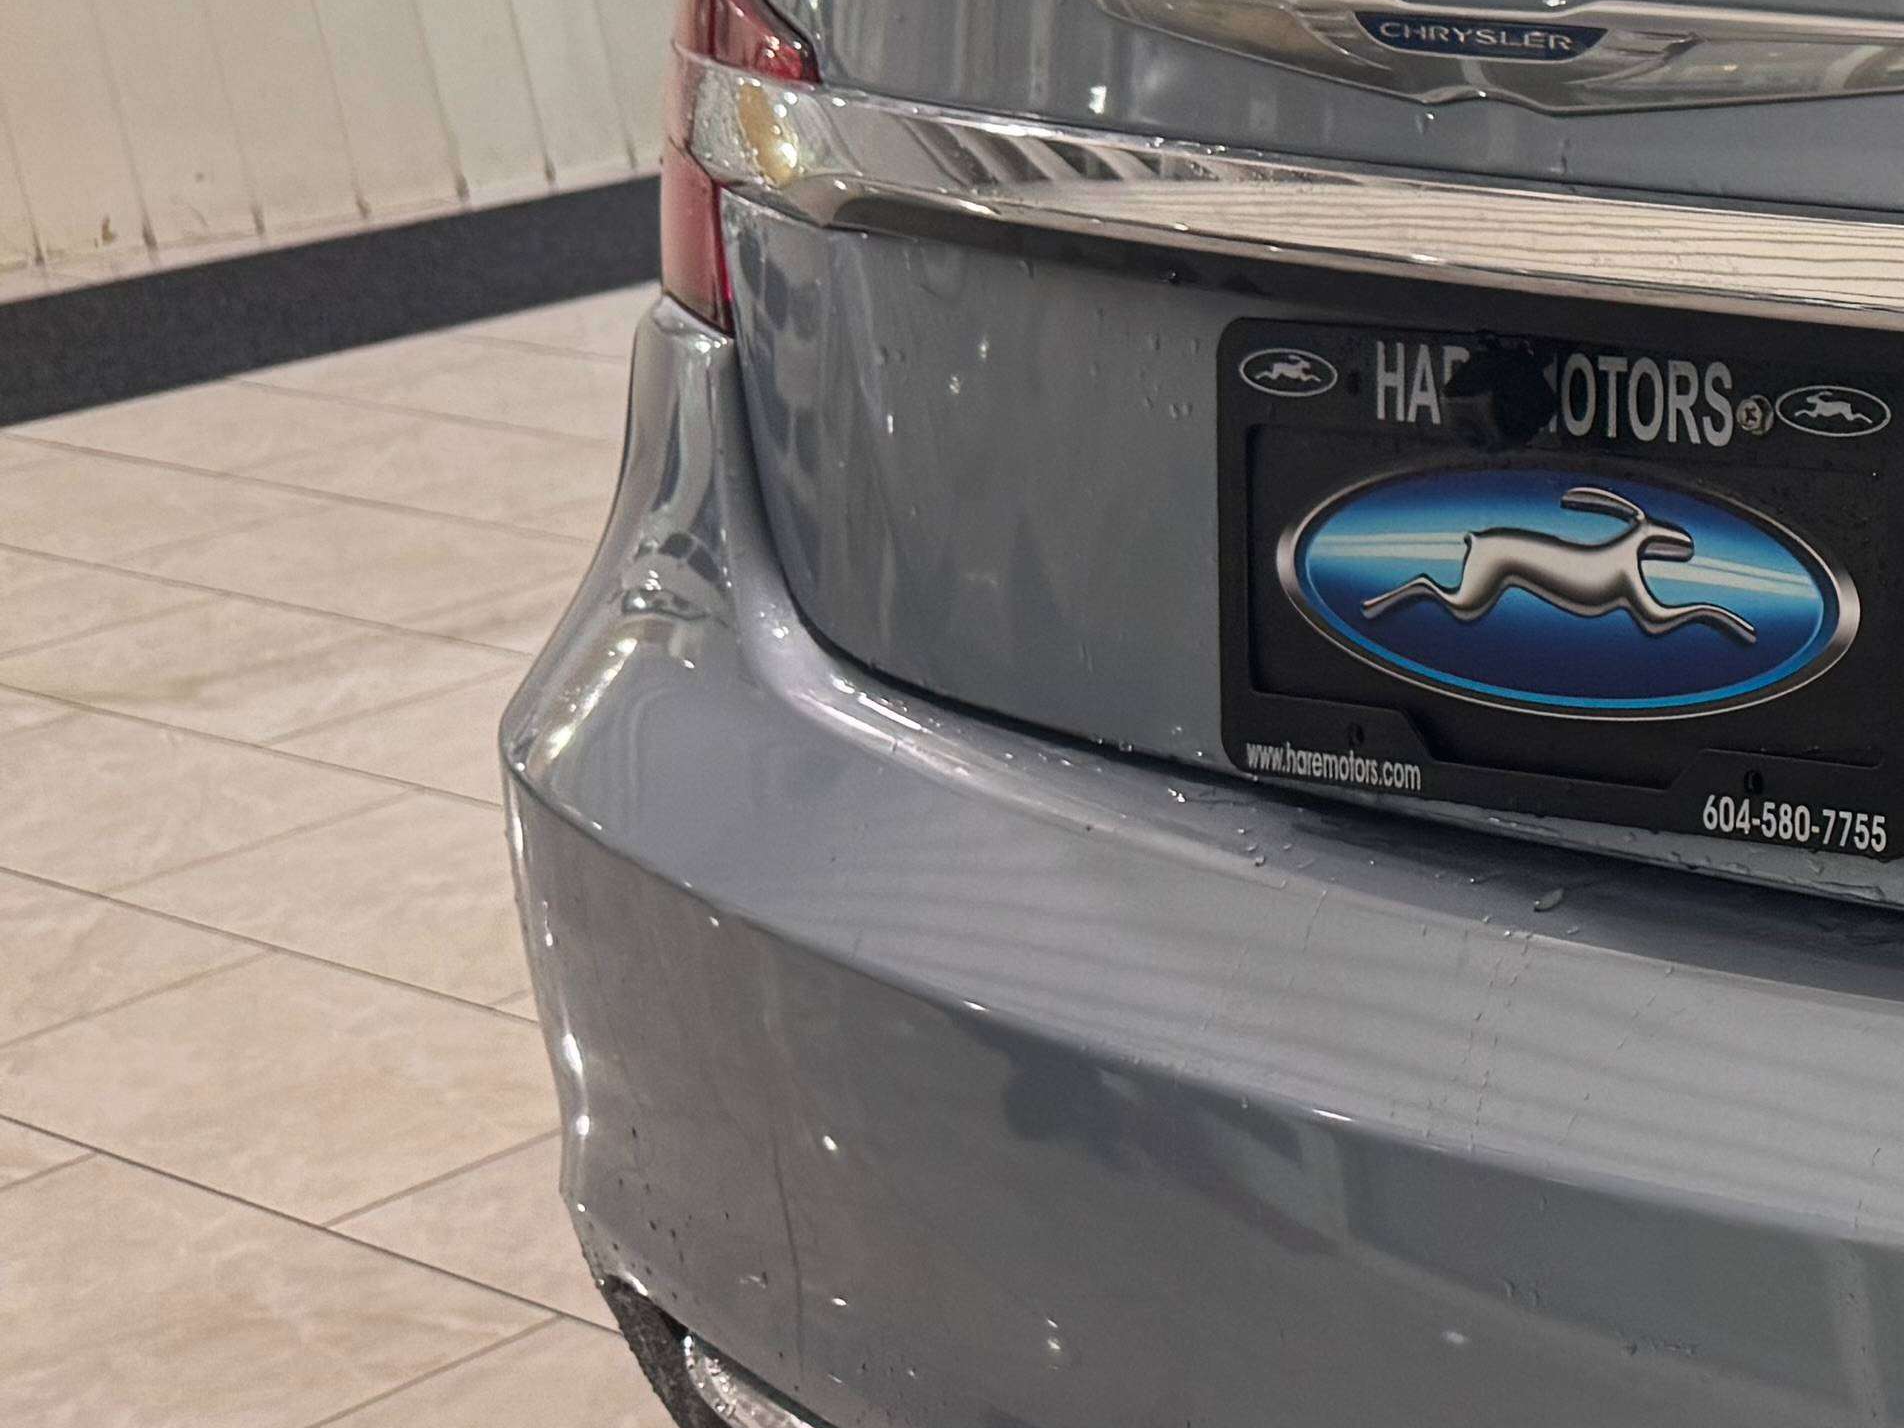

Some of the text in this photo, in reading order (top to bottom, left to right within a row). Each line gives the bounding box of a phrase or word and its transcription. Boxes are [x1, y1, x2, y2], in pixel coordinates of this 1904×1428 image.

[1379, 21, 1574, 51] CHRYSLER
[1375, 340, 1735, 448] HA OTORS
[1246, 741, 1422, 791] www.haremotors.com
[1702, 794, 1887, 852] 604-580-7755
